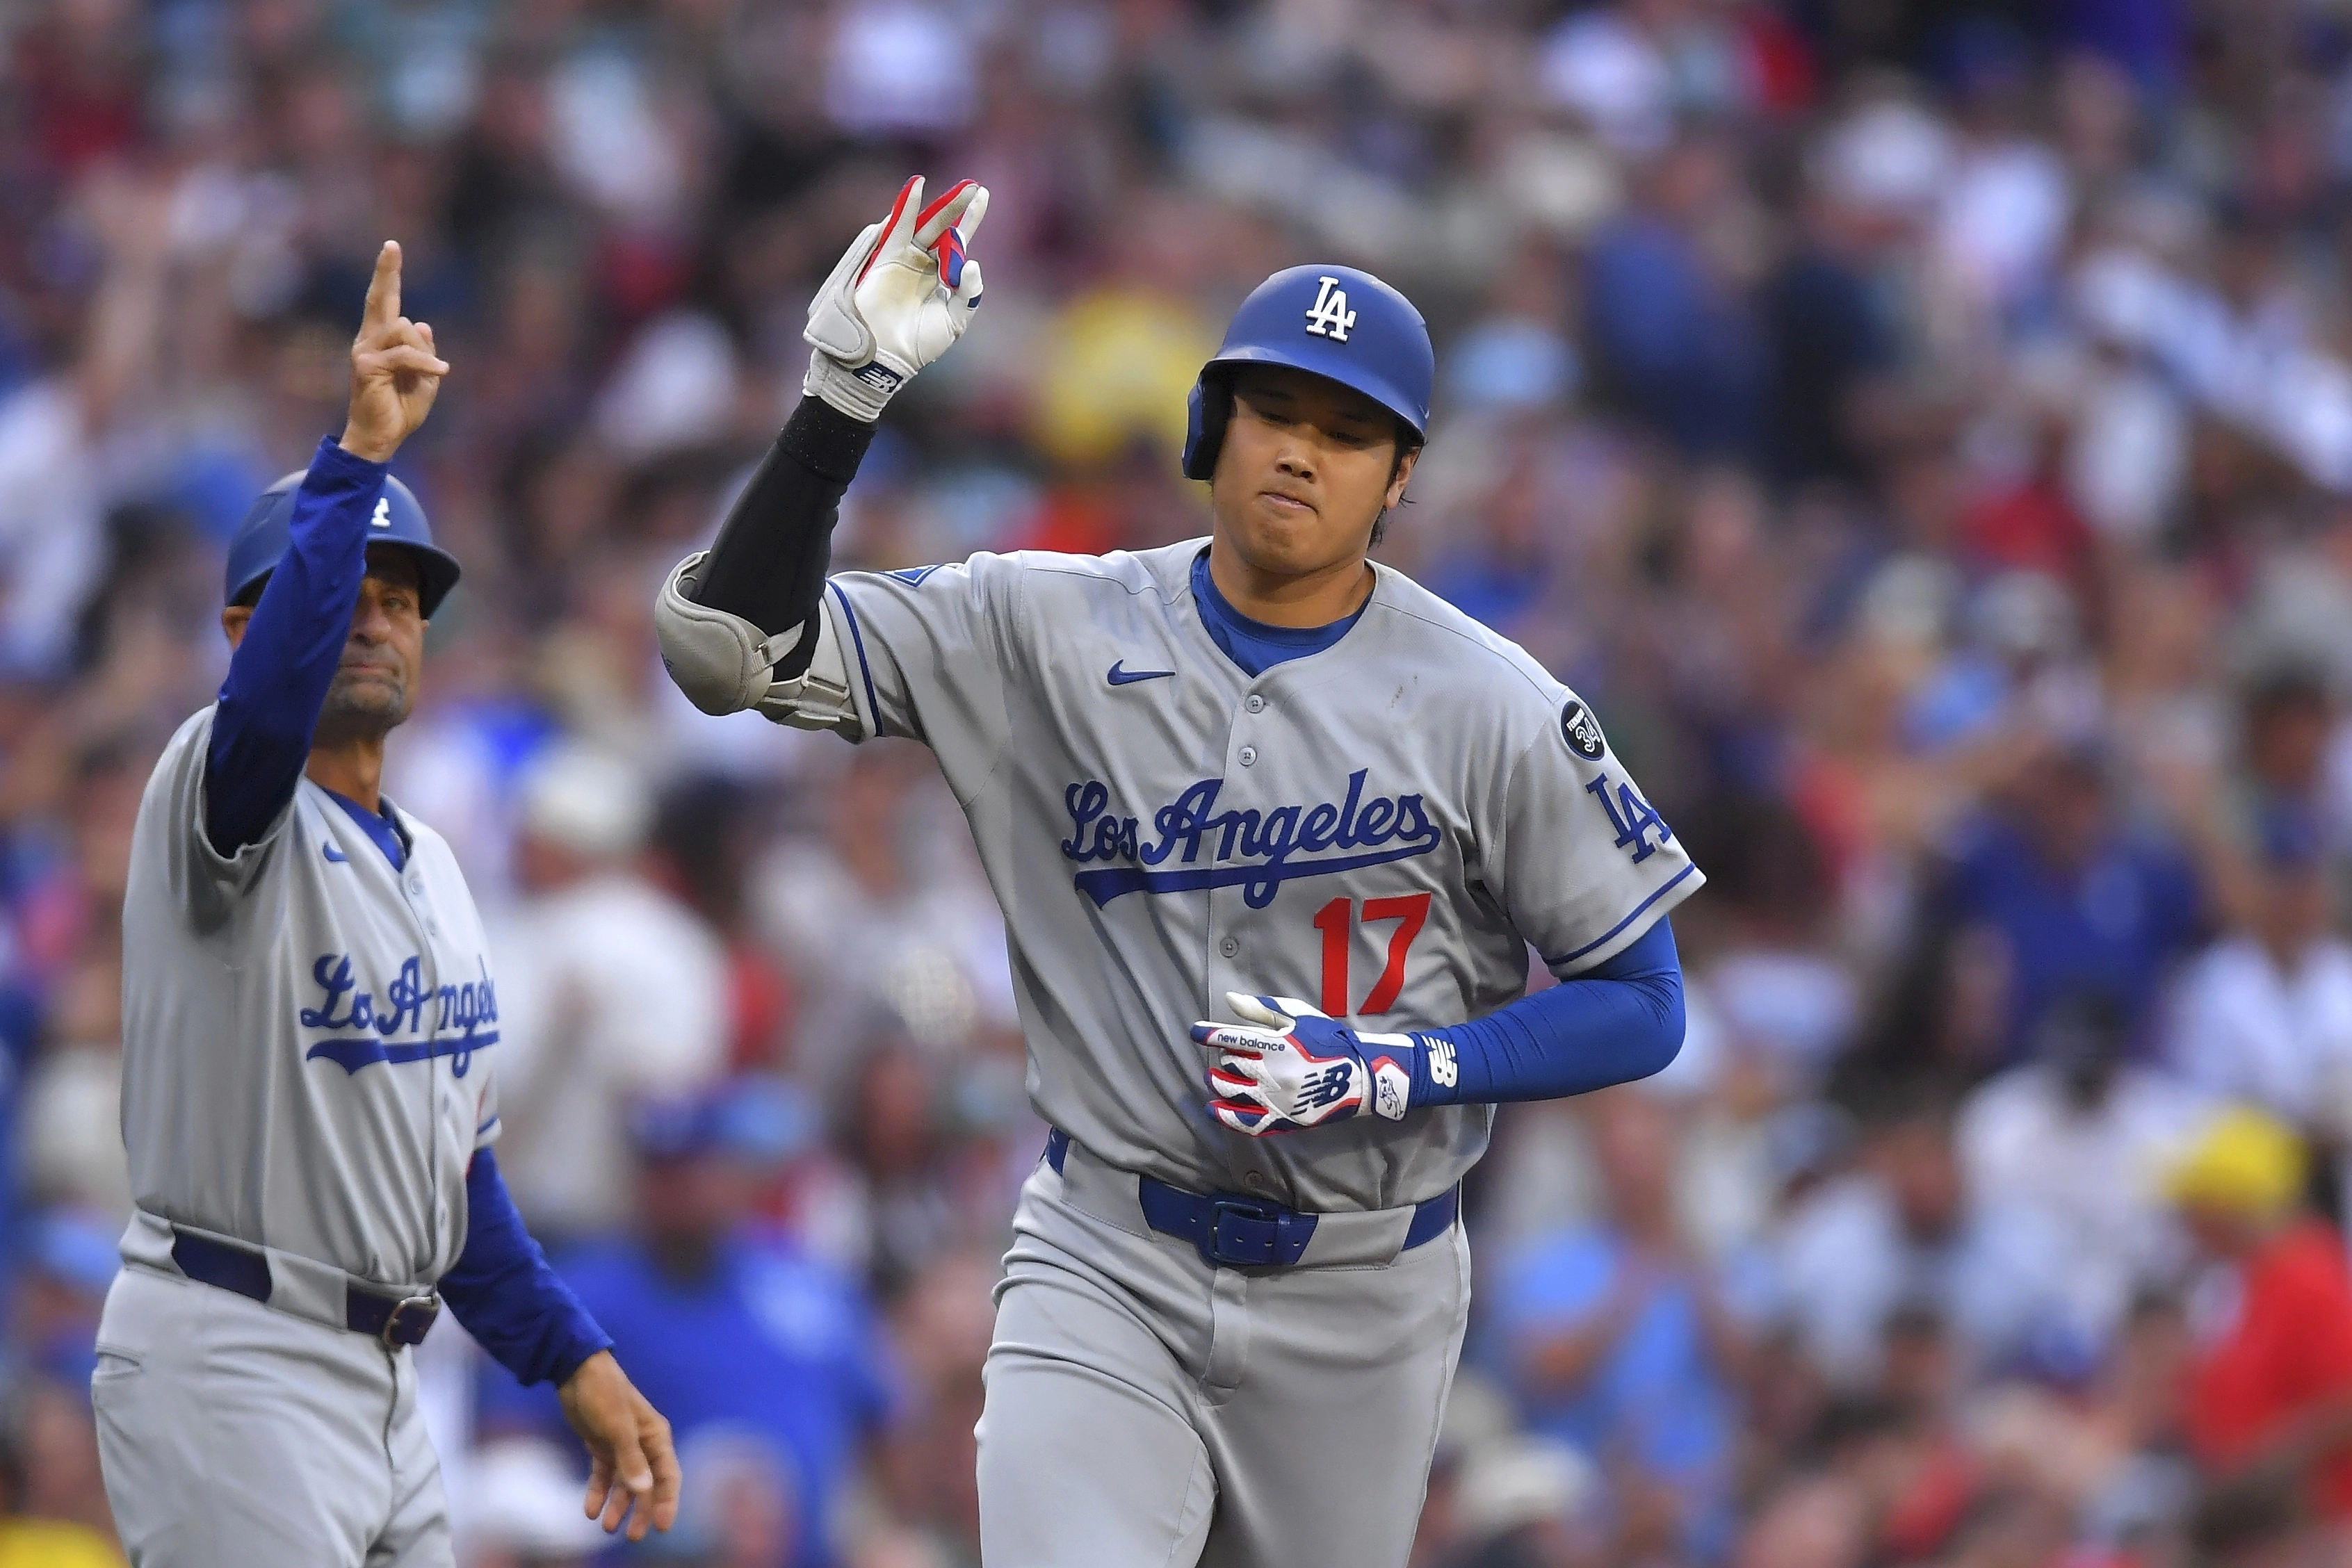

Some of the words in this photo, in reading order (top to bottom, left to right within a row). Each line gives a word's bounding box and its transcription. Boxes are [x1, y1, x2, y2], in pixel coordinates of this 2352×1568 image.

[1306, 276, 1357, 342] LA
[1575, 717, 1601, 753] 34
[1062, 779, 1140, 862] Los
[1139, 767, 1442, 909] Angeles
[1584, 772, 1671, 864] LA
[1313, 892, 1432, 1018] 17
[1217, 1033, 1238, 1044] new
[1239, 1036, 1286, 1052] balance
